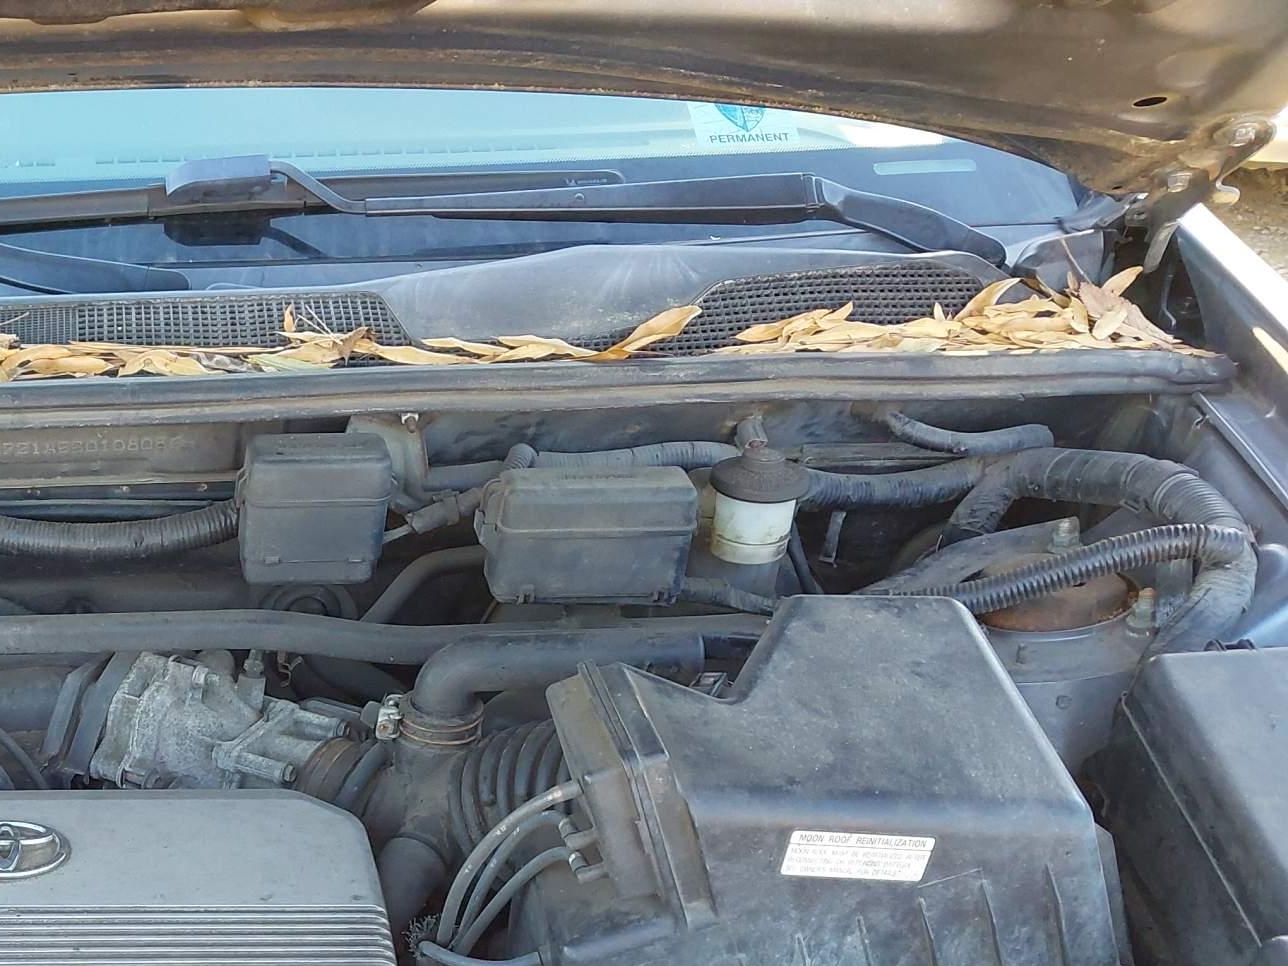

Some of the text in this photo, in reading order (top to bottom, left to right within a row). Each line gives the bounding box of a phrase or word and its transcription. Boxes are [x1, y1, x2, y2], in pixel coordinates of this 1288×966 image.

[710, 132, 790, 144] PERMANENT
[798, 834, 928, 848] MOON ROOF REINITIALIZATION
